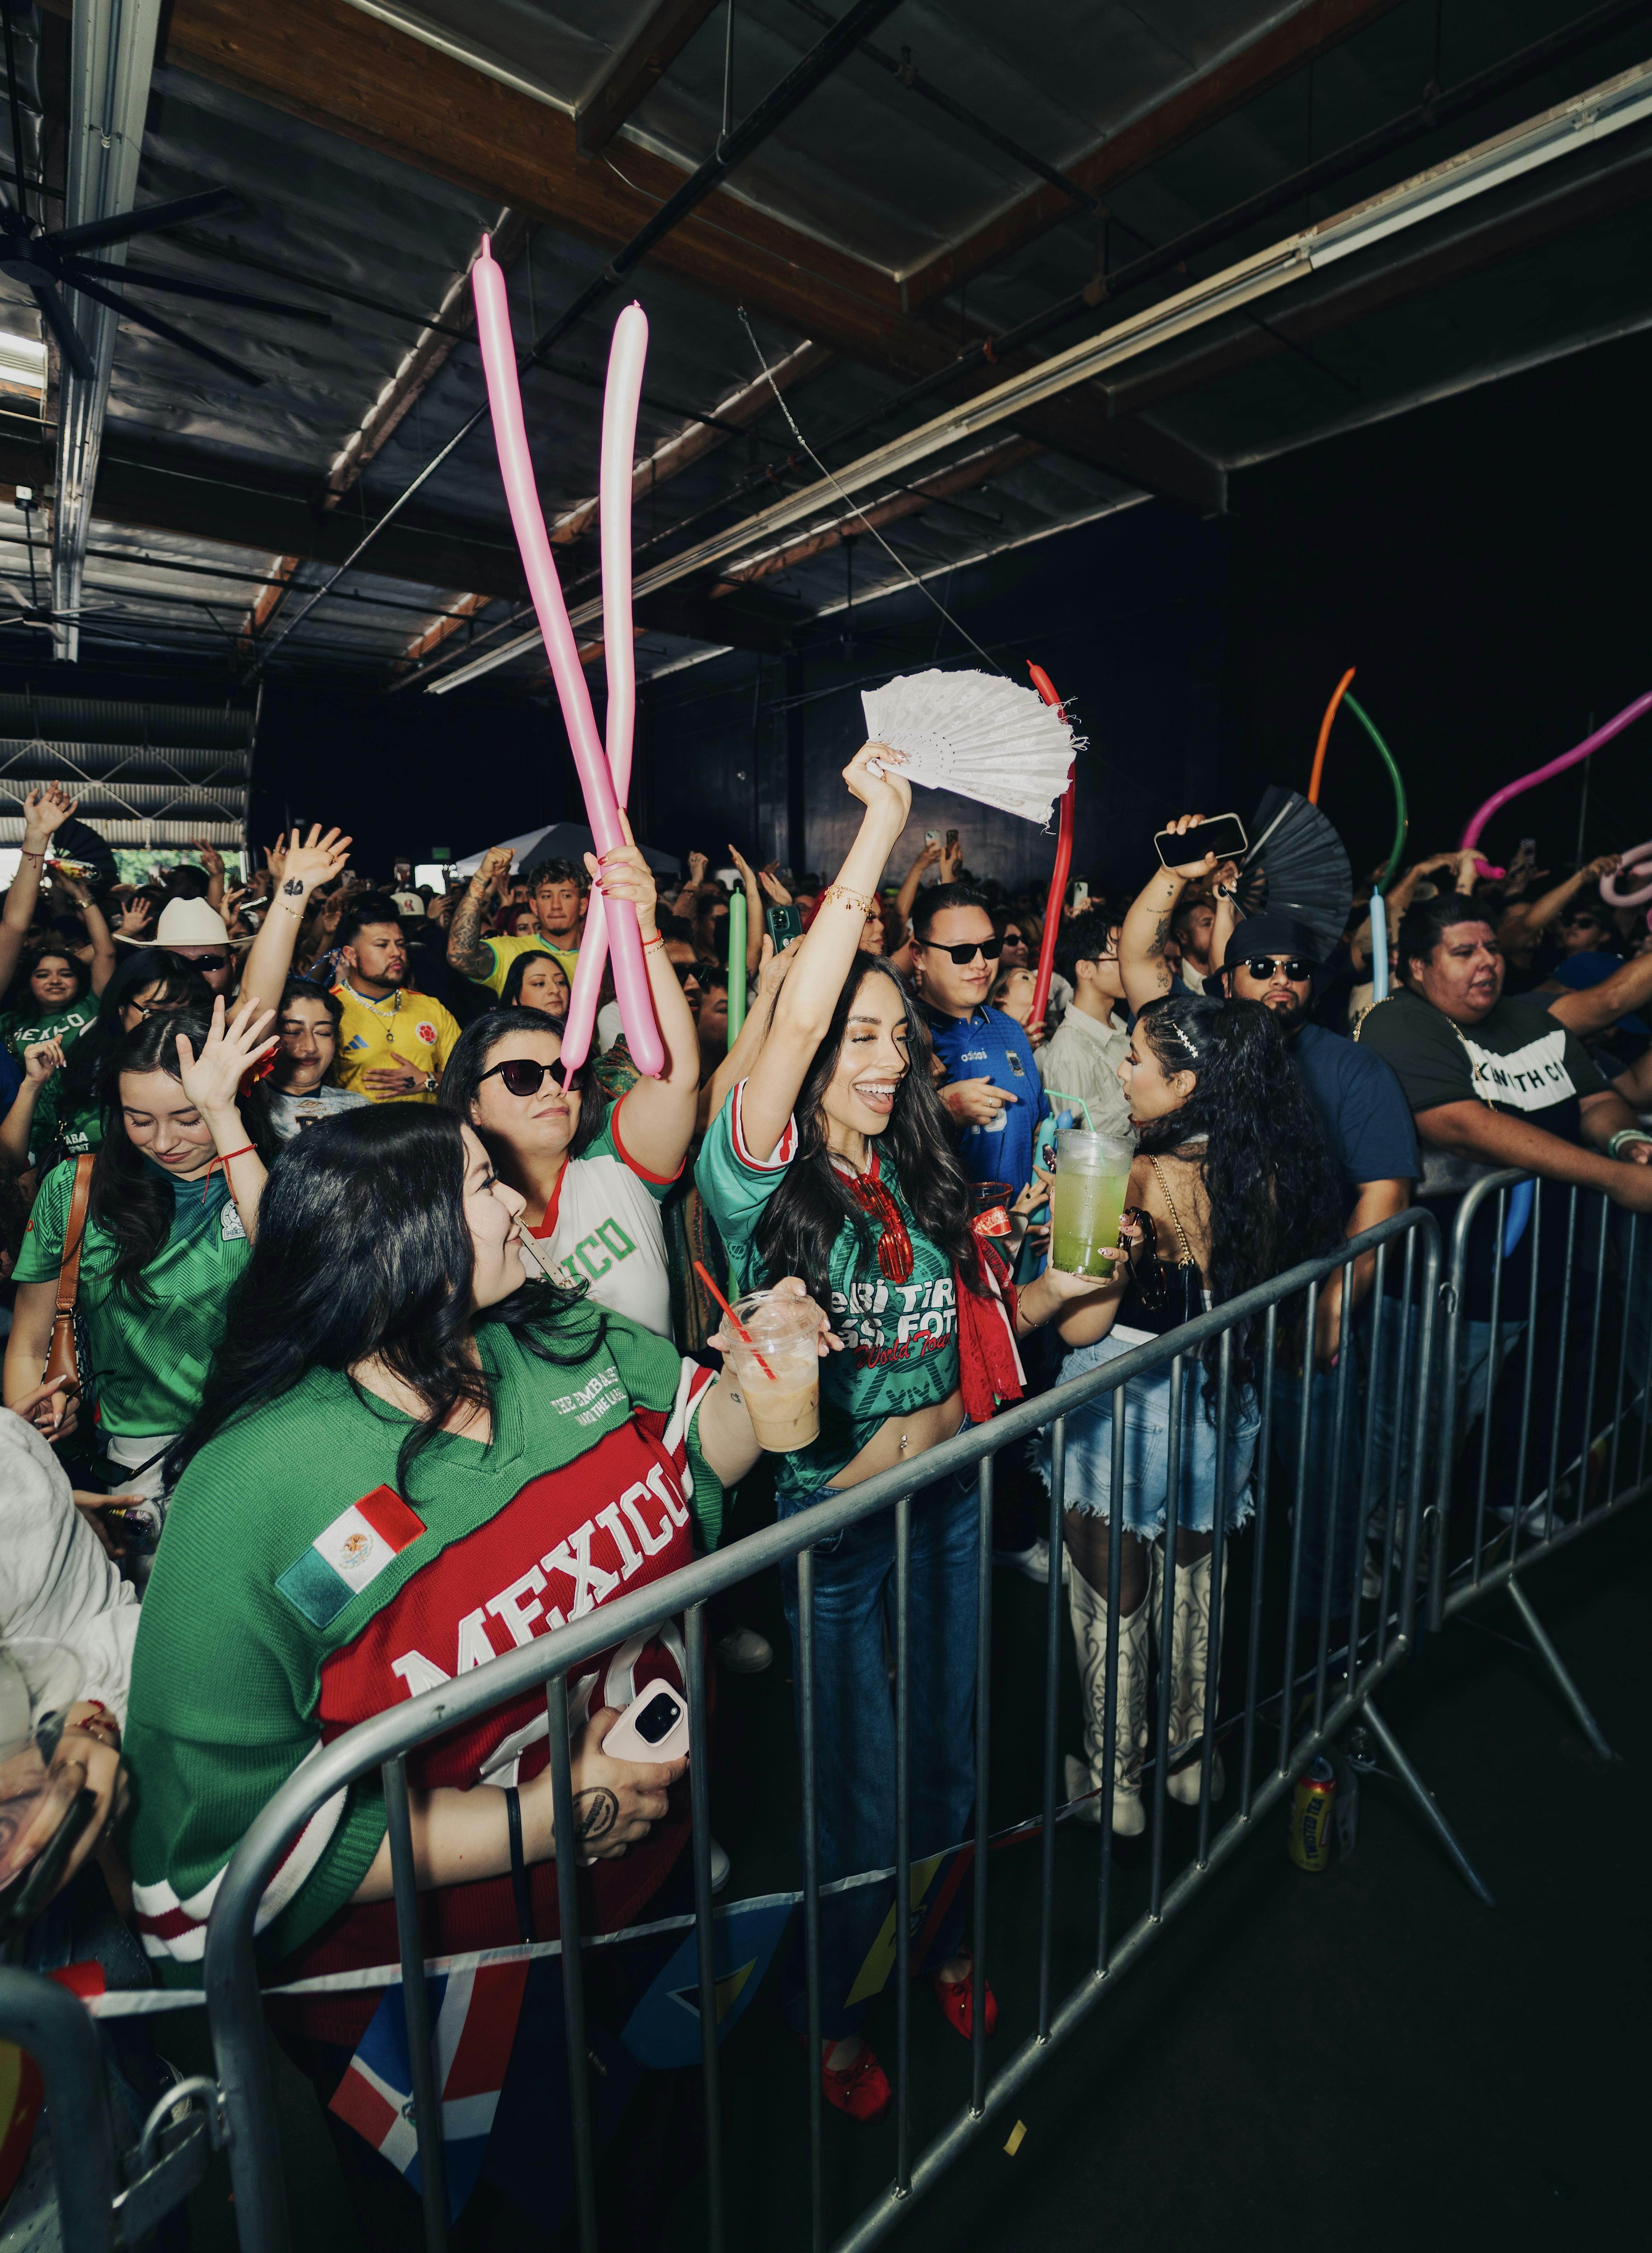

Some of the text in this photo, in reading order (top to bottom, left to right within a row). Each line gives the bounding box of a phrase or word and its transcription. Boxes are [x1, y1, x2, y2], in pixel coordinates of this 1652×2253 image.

[65, 1132, 88, 1145] ABA
[226, 1226, 244, 1236] MÉX
[540, 1216, 639, 1294] ICO
[832, 1277, 956, 1314] eBÍ TiR
[837, 1308, 958, 1349] áS FOT
[852, 1329, 951, 1369] World Tour
[551, 1366, 618, 1415] THE EMBAS
[591, 1397, 610, 1418] THE
[391, 1462, 690, 1697] MEXICO
[1307, 1797, 1326, 1816] TEA
[1303, 1815, 1319, 1859] TWISTED
